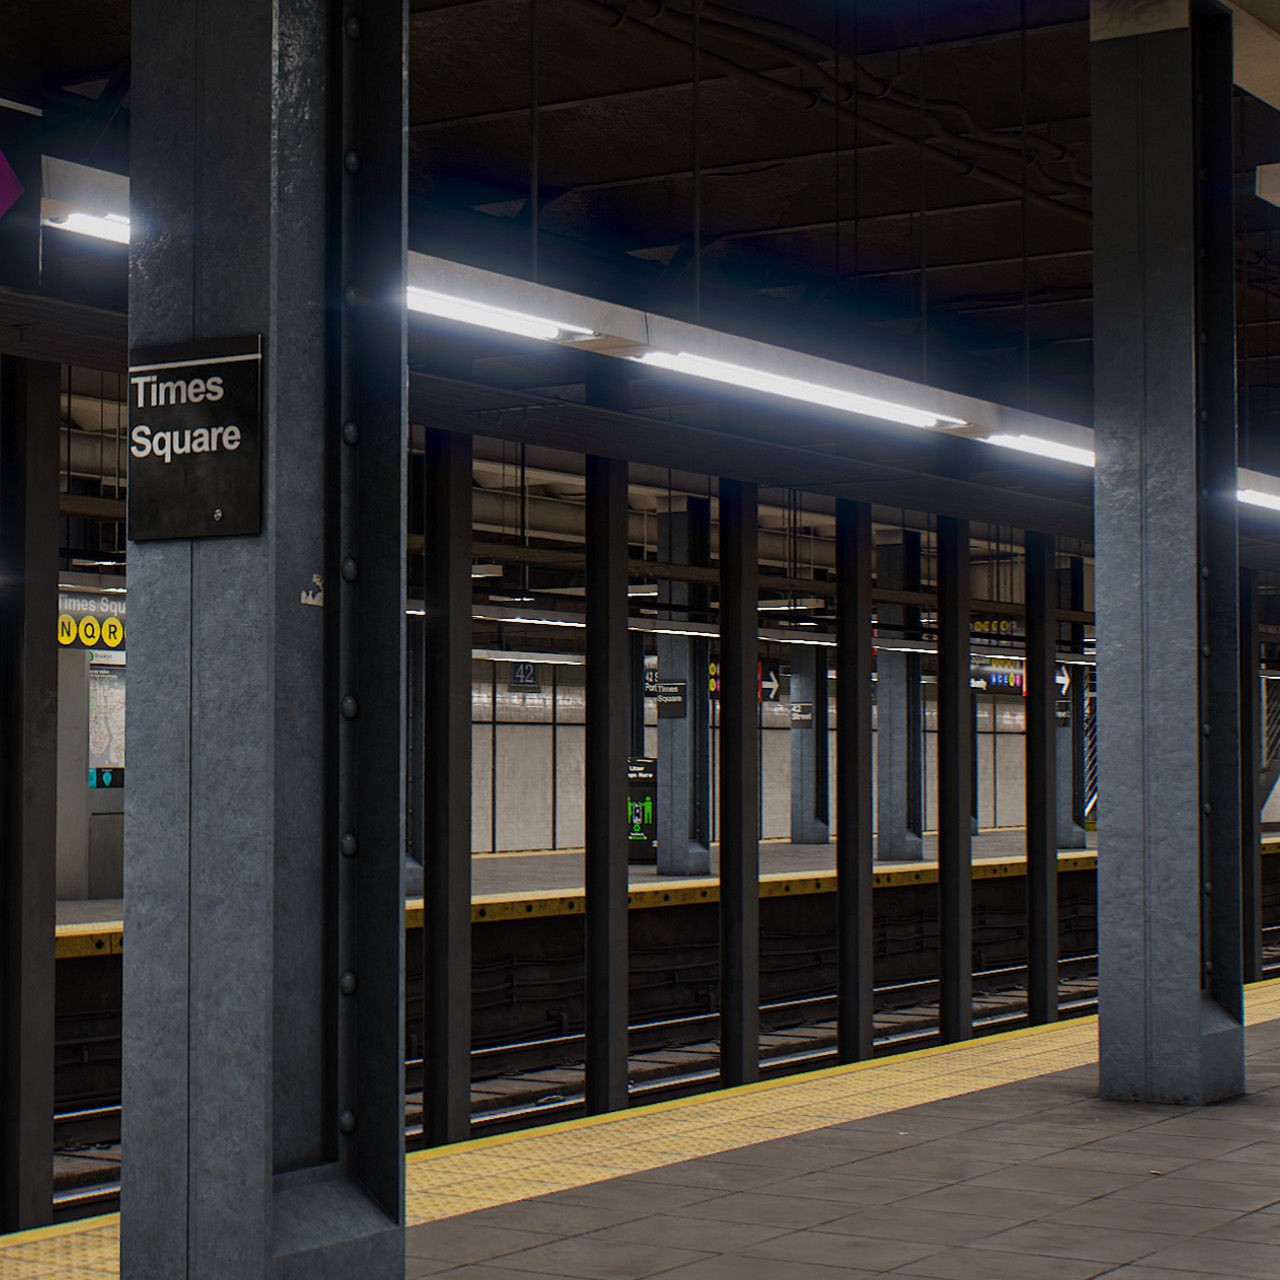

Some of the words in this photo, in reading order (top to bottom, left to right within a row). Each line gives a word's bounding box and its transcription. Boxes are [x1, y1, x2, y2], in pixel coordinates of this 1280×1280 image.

[131, 374, 224, 407] Times
[130, 424, 242, 463] Square
[84, 622, 96, 639] Q
[515, 663, 536, 683] 42
